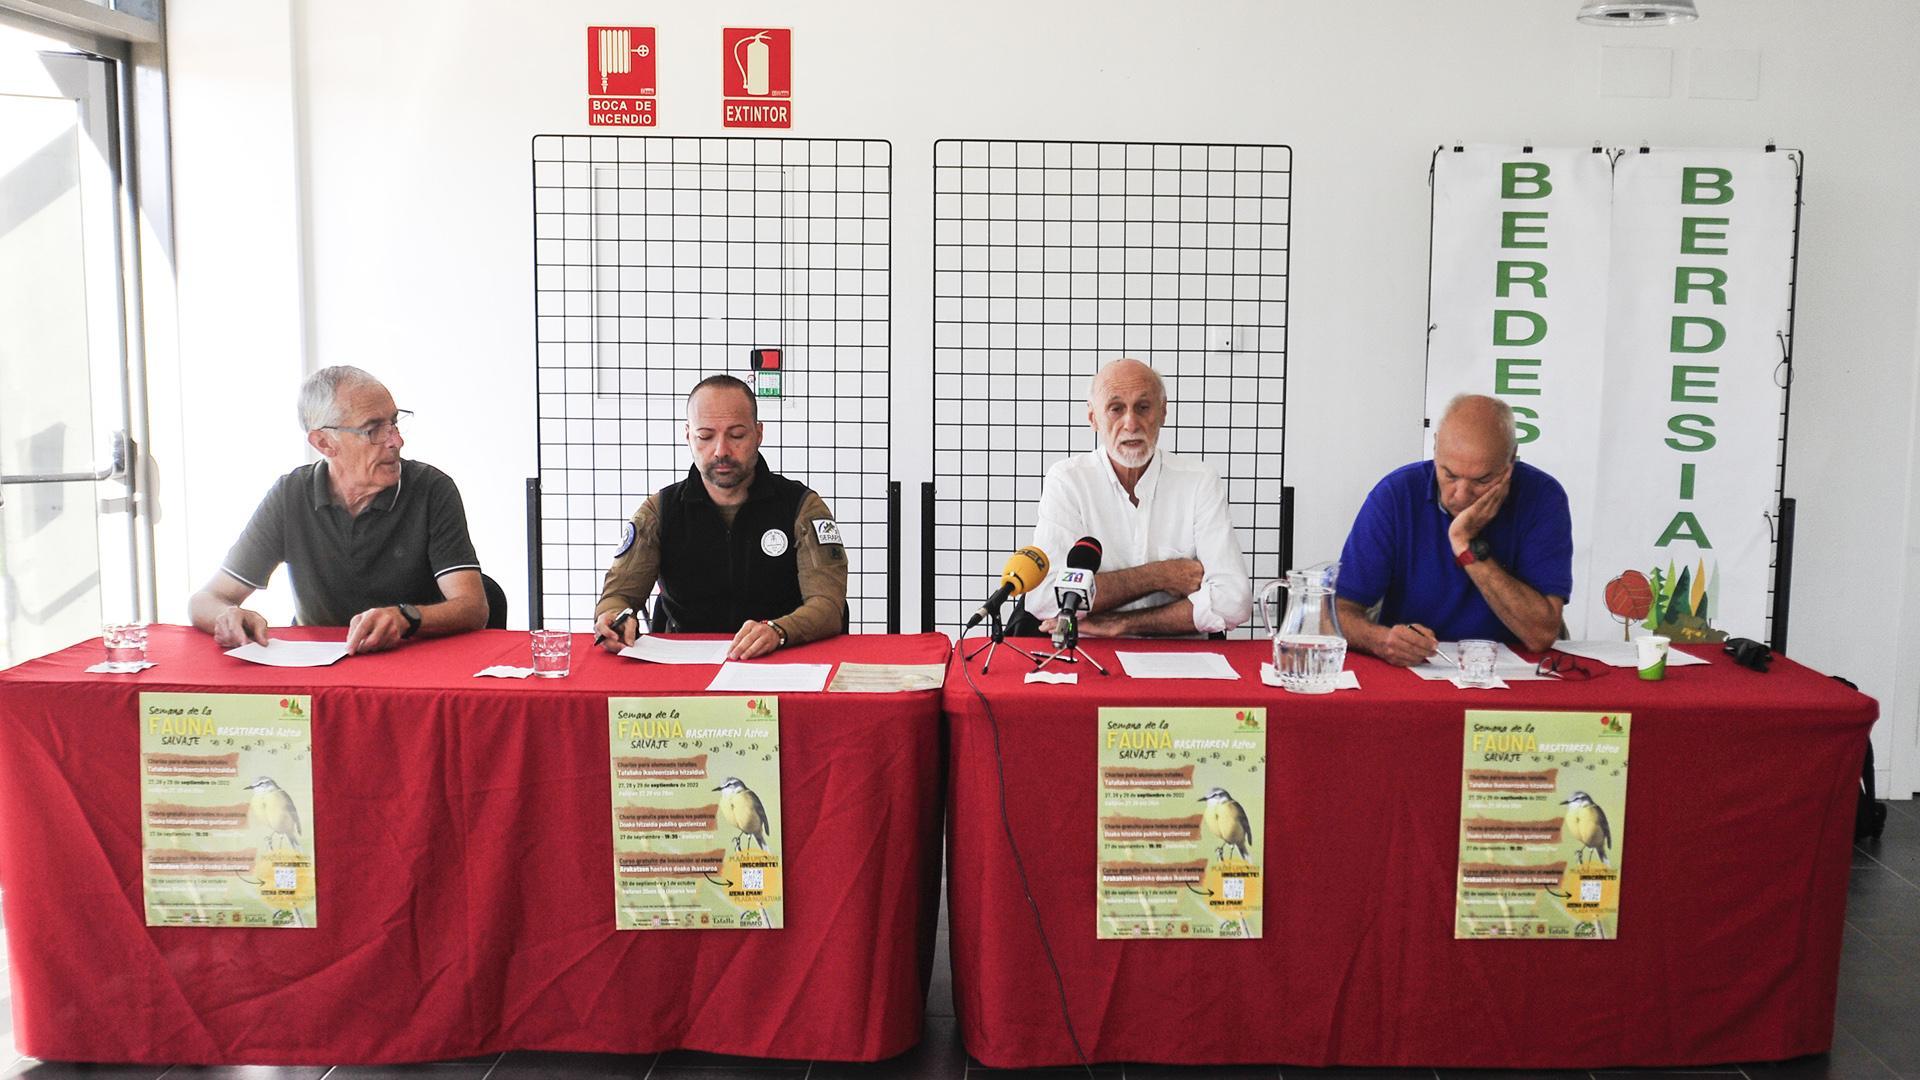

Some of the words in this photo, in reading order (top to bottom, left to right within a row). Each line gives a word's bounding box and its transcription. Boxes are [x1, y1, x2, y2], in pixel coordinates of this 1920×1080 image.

[593, 101, 628, 111] BOCA
[635, 101, 652, 111] DE
[593, 113, 652, 125] INCENDIO
[726, 105, 787, 123] EXTINTOR
[1493, 162, 1553, 461] BERDES
[1654, 167, 1735, 549] BERDESIA
[148, 706, 183, 716] Semana
[186, 707, 198, 717] de
[201, 706, 212, 717] la
[618, 710, 652, 720] Semana
[655, 710, 667, 720] de
[669, 709, 681, 720] la
[618, 720, 684, 739] FAUNA
[686, 728, 742, 740] BASATIAREN
[1107, 720, 1142, 730] Semana
[1145, 721, 1156, 730] de
[1159, 720, 1170, 730] la
[1474, 723, 1508, 733] Semana
[1511, 724, 1522, 733] de
[1525, 723, 1536, 734] la
[161, 736, 202, 747] SALVAJE
[630, 739, 670, 750] SALVAJE
[1107, 731, 1172, 749] FAUNA
[1119, 750, 1158, 760] SALVAJE
[1484, 753, 1523, 763] SALVAJE
